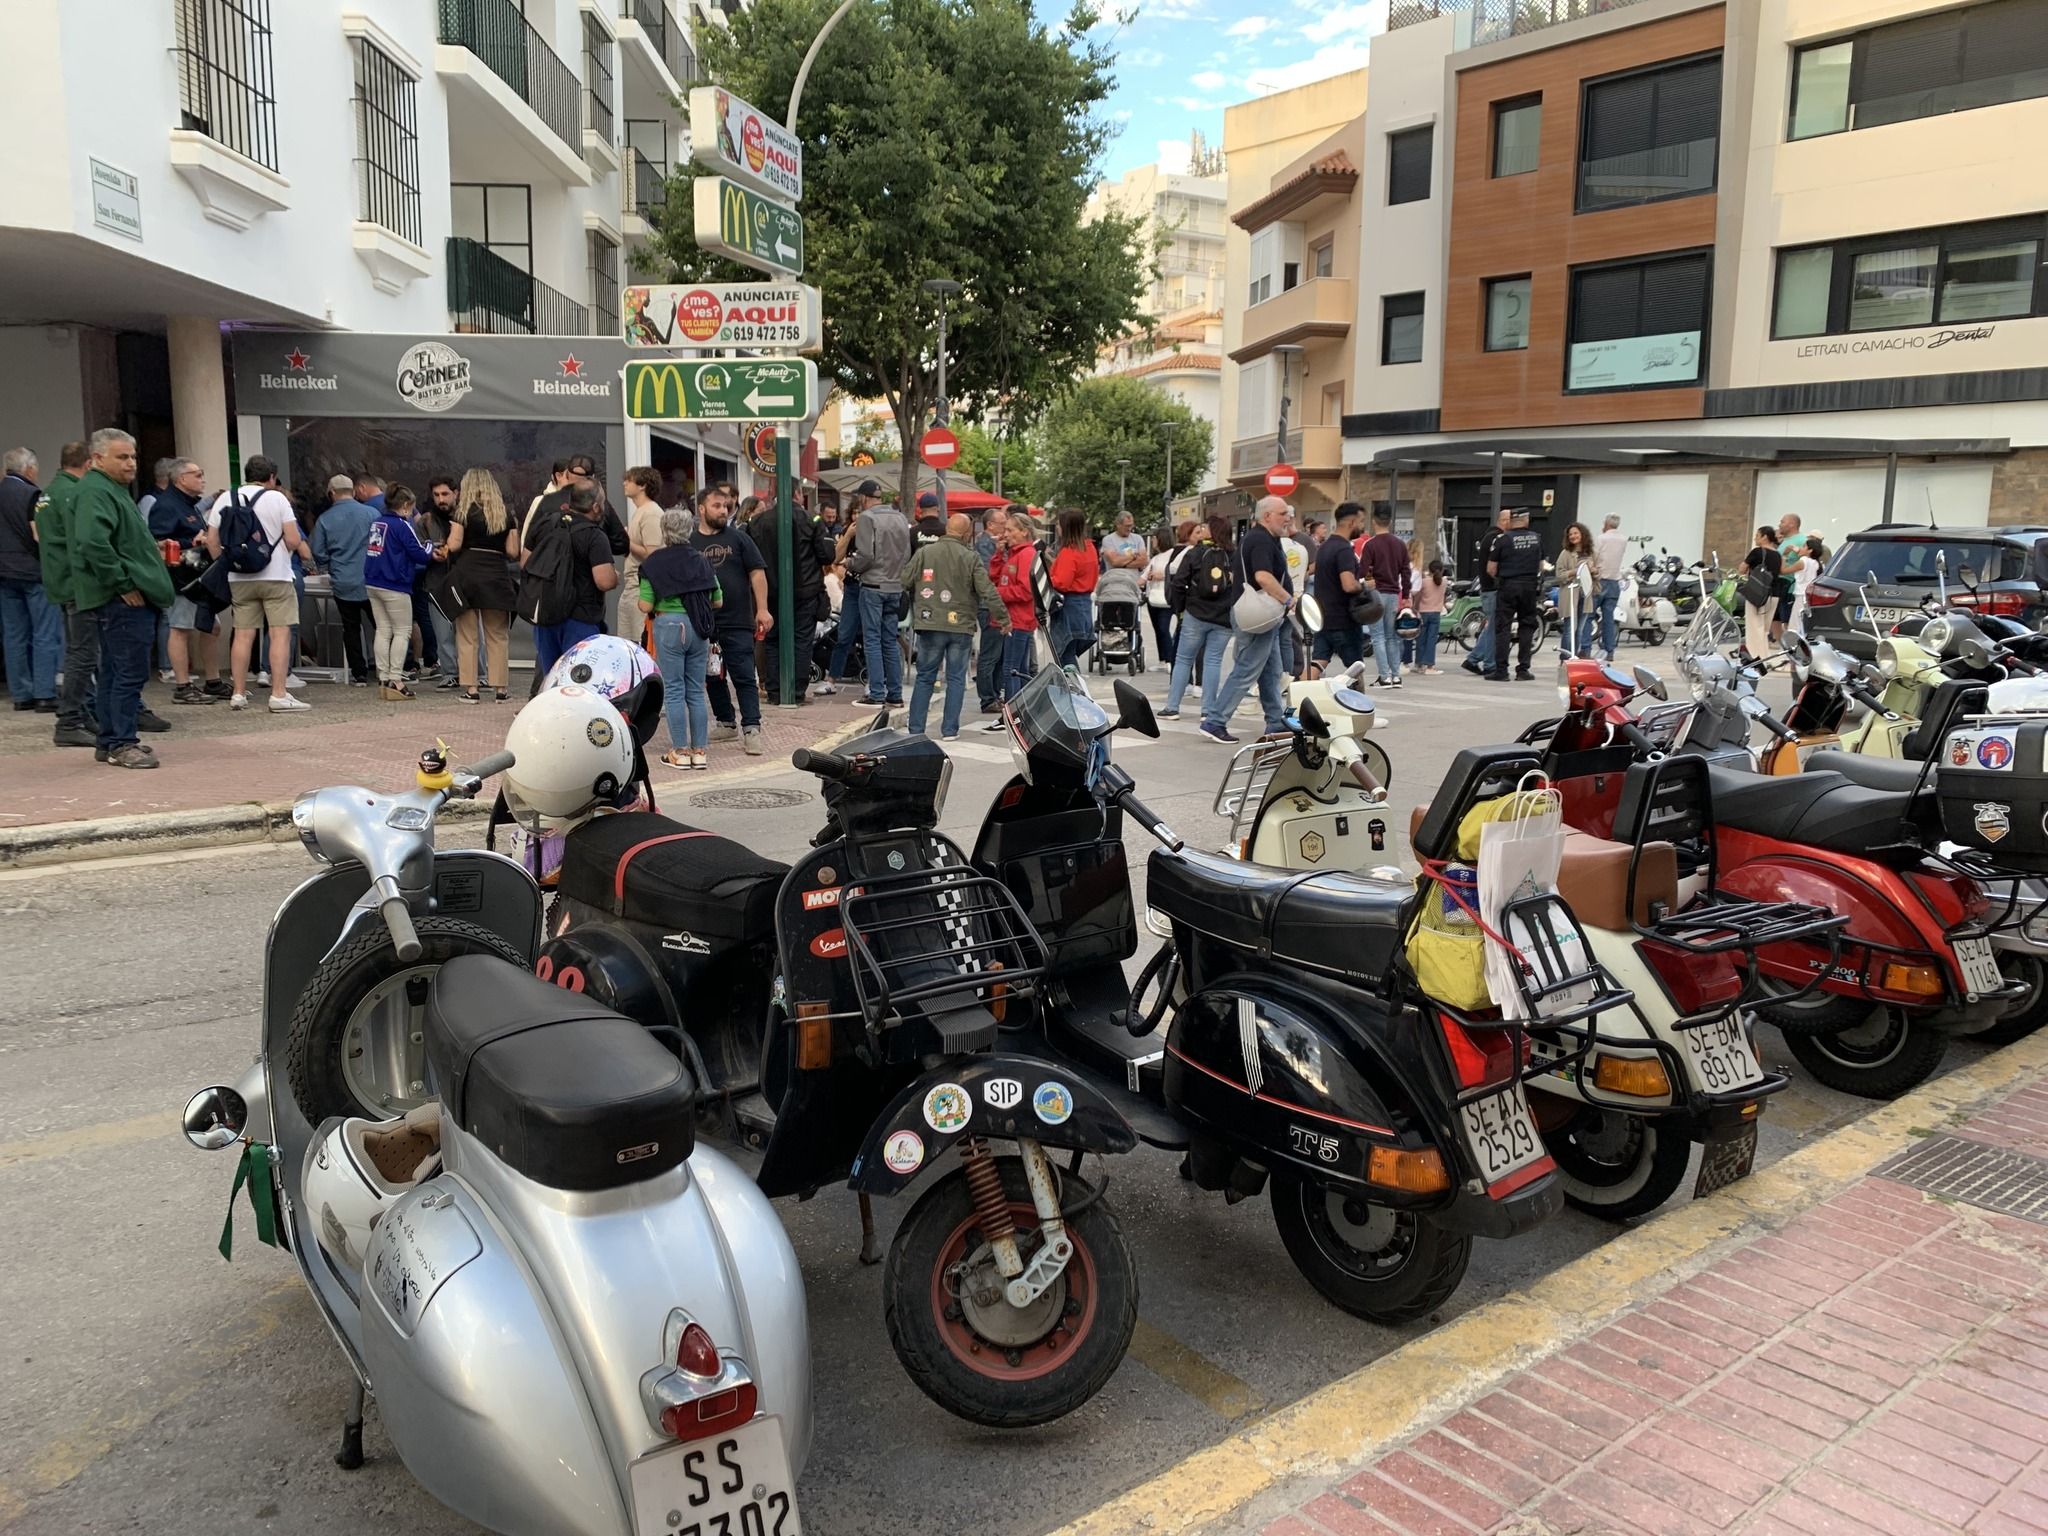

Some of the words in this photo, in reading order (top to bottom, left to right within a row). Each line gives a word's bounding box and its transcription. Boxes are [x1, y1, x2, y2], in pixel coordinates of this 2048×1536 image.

[766, 145, 798, 176] AQUÍ
[98, 202, 111, 218] San
[683, 295, 709, 310] ¿me
[723, 289, 800, 302] ANÚNCIATE
[691, 305, 721, 318] ves?
[725, 302, 798, 325] AQUÍ
[680, 319, 692, 328] TUS
[692, 319, 720, 328] CLIENTES
[733, 327, 753, 341] 619
[756, 326, 776, 340] 472
[780, 326, 800, 340] 758
[1797, 343, 1848, 358] LETRÁN
[1852, 336, 1925, 353] CAMACHO
[1928, 325, 1995, 349] Dental
[706, 374, 720, 385] 24
[757, 367, 789, 377] McAuto
[259, 374, 338, 390] Heineken
[418, 387, 442, 399] BISTRO
[454, 380, 468, 391] BAR
[533, 379, 610, 396] Heineken
[701, 400, 726, 408] Viernes
[750, 422, 774, 439] PAUL
[807, 887, 862, 907] MOTUL
[819, 939, 846, 953] Vesp
[1969, 961, 1999, 992] 1148
[1701, 1049, 1755, 1089] 8912
[990, 1082, 1018, 1104] SIP
[1289, 1125, 1340, 1163] T5
[1479, 1119, 1534, 1172] 2529
[683, 1439, 744, 1507] SS
